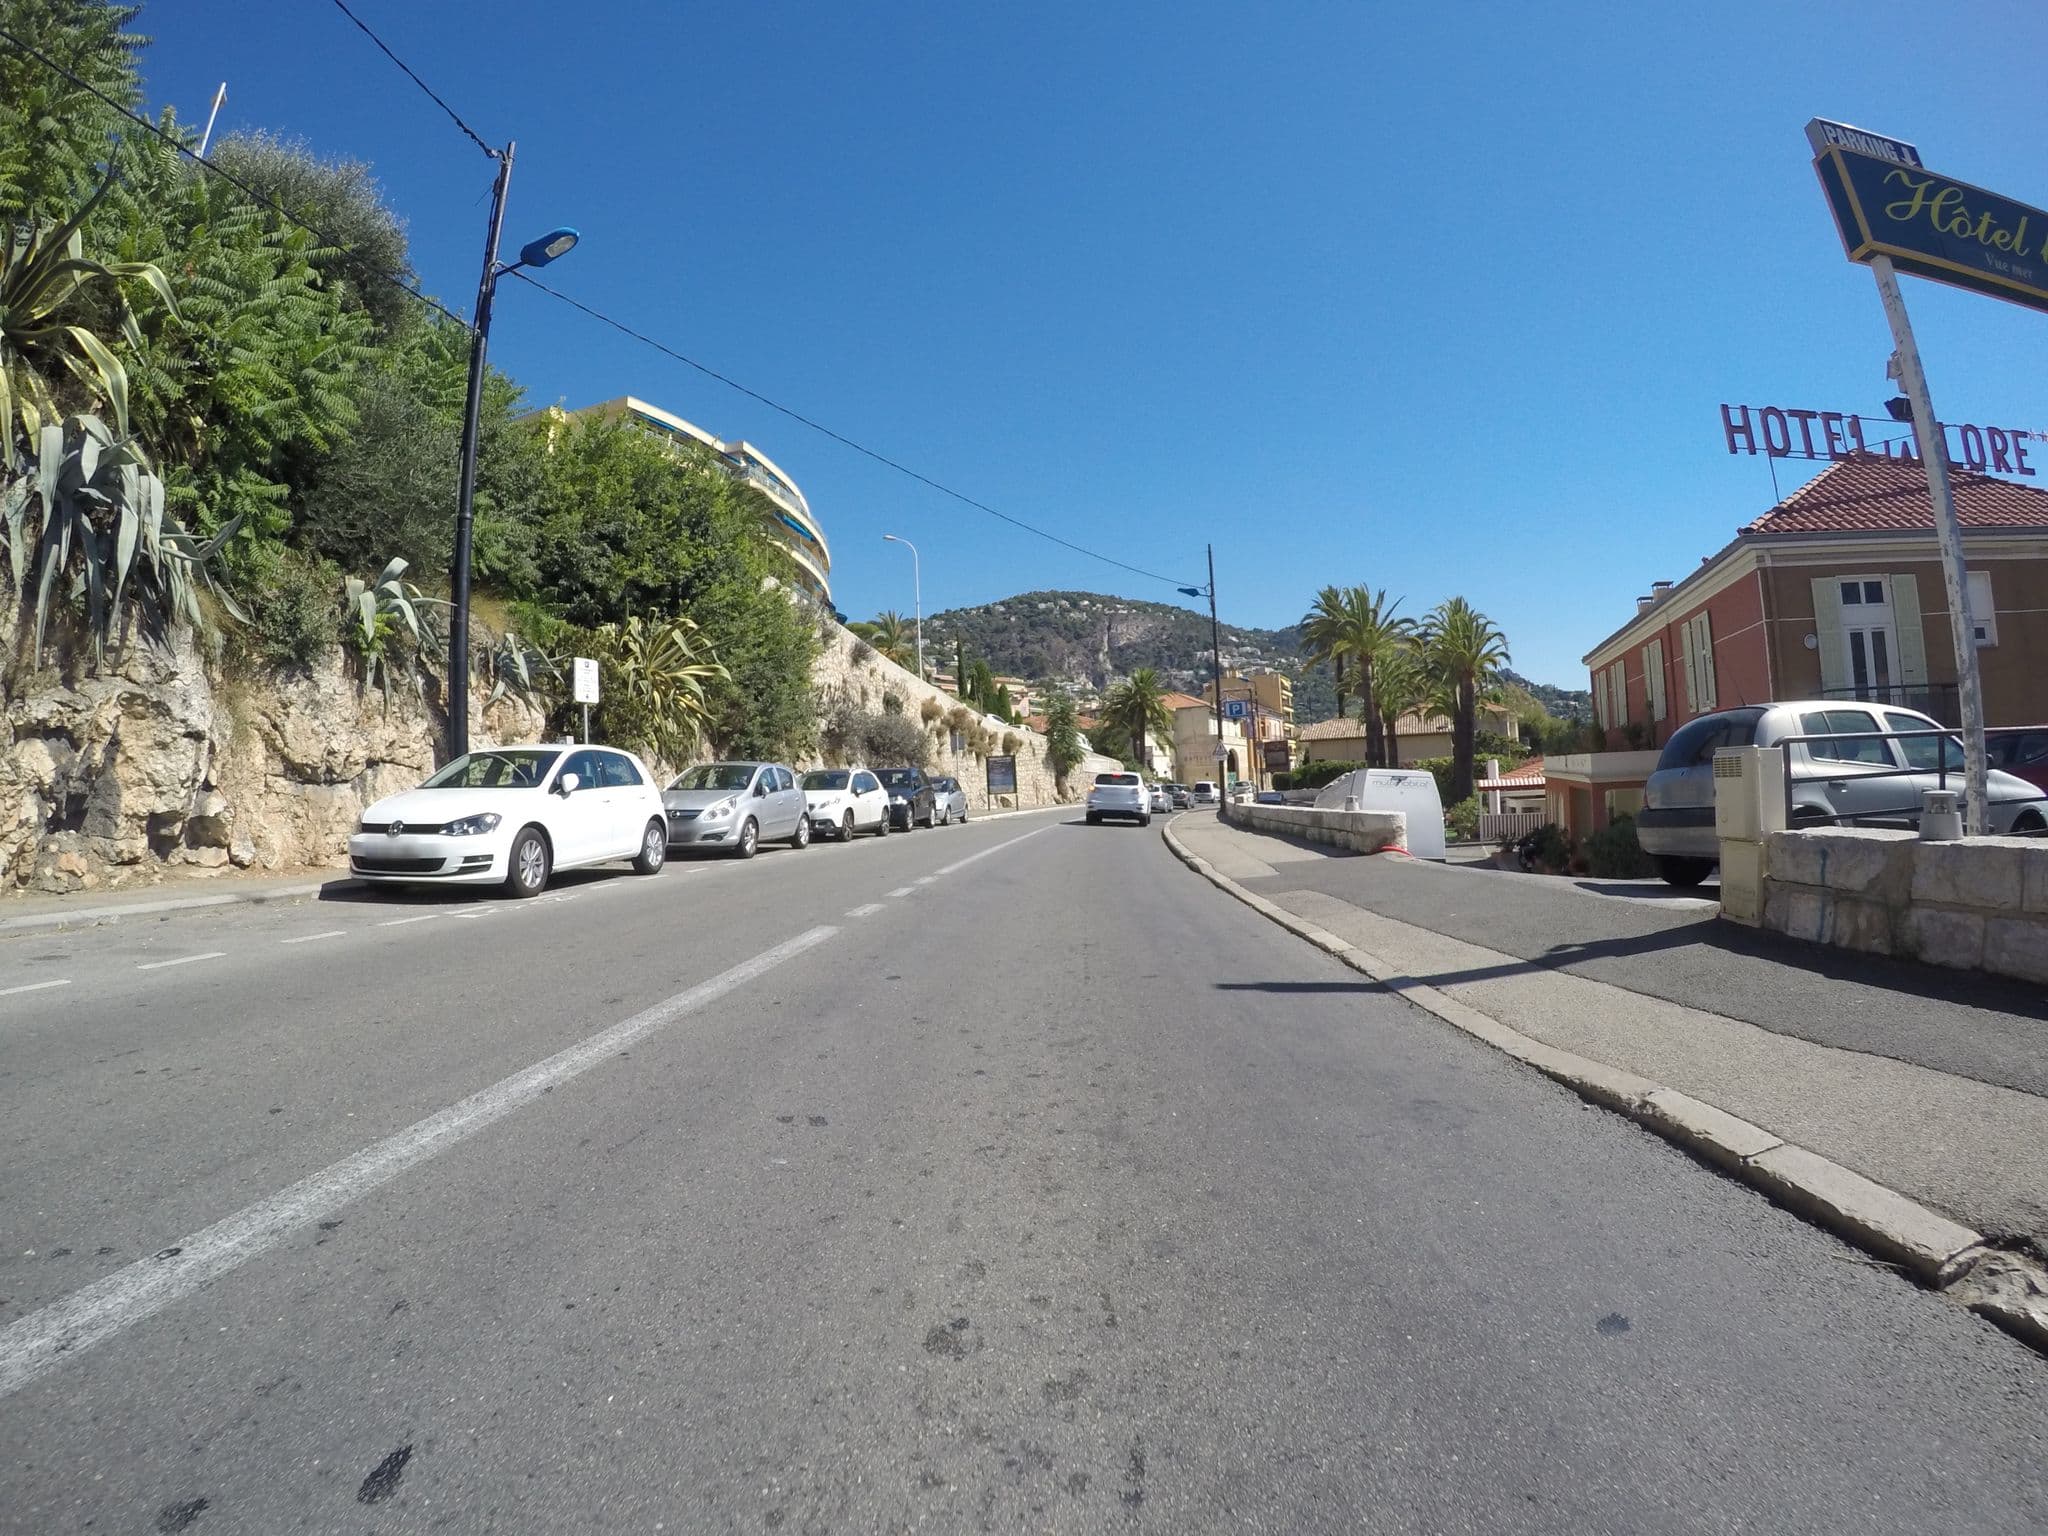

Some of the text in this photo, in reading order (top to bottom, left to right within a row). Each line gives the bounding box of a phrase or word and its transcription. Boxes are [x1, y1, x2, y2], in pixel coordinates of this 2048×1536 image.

[1823, 124, 1900, 162] PARKING
[1883, 169, 2030, 257] Hôtel
[1720, 403, 1874, 461] HOTEL
[1910, 420, 2036, 476] LORE
